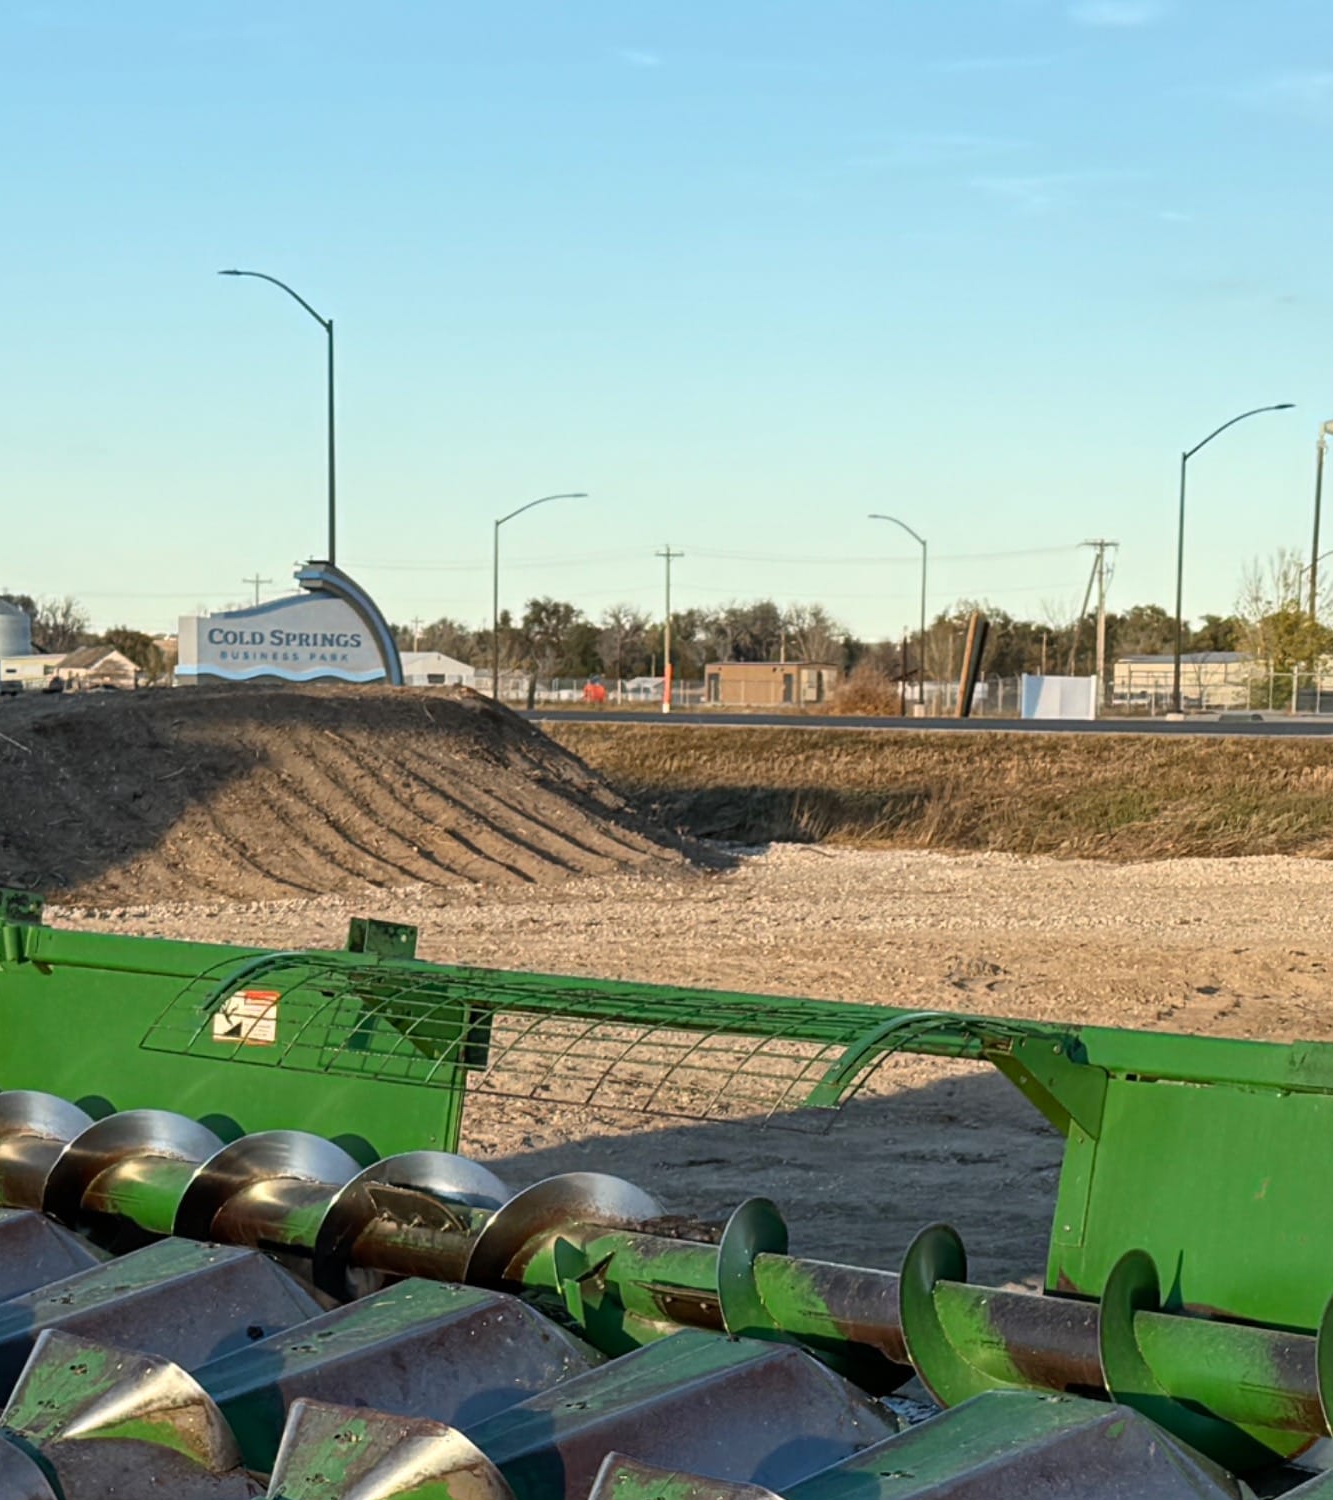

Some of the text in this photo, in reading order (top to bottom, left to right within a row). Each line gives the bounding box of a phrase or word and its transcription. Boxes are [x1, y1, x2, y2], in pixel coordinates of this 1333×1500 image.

[208, 627, 362, 648] COLD SPRINGS
[219, 651, 349, 662] BUSINESS PARK
